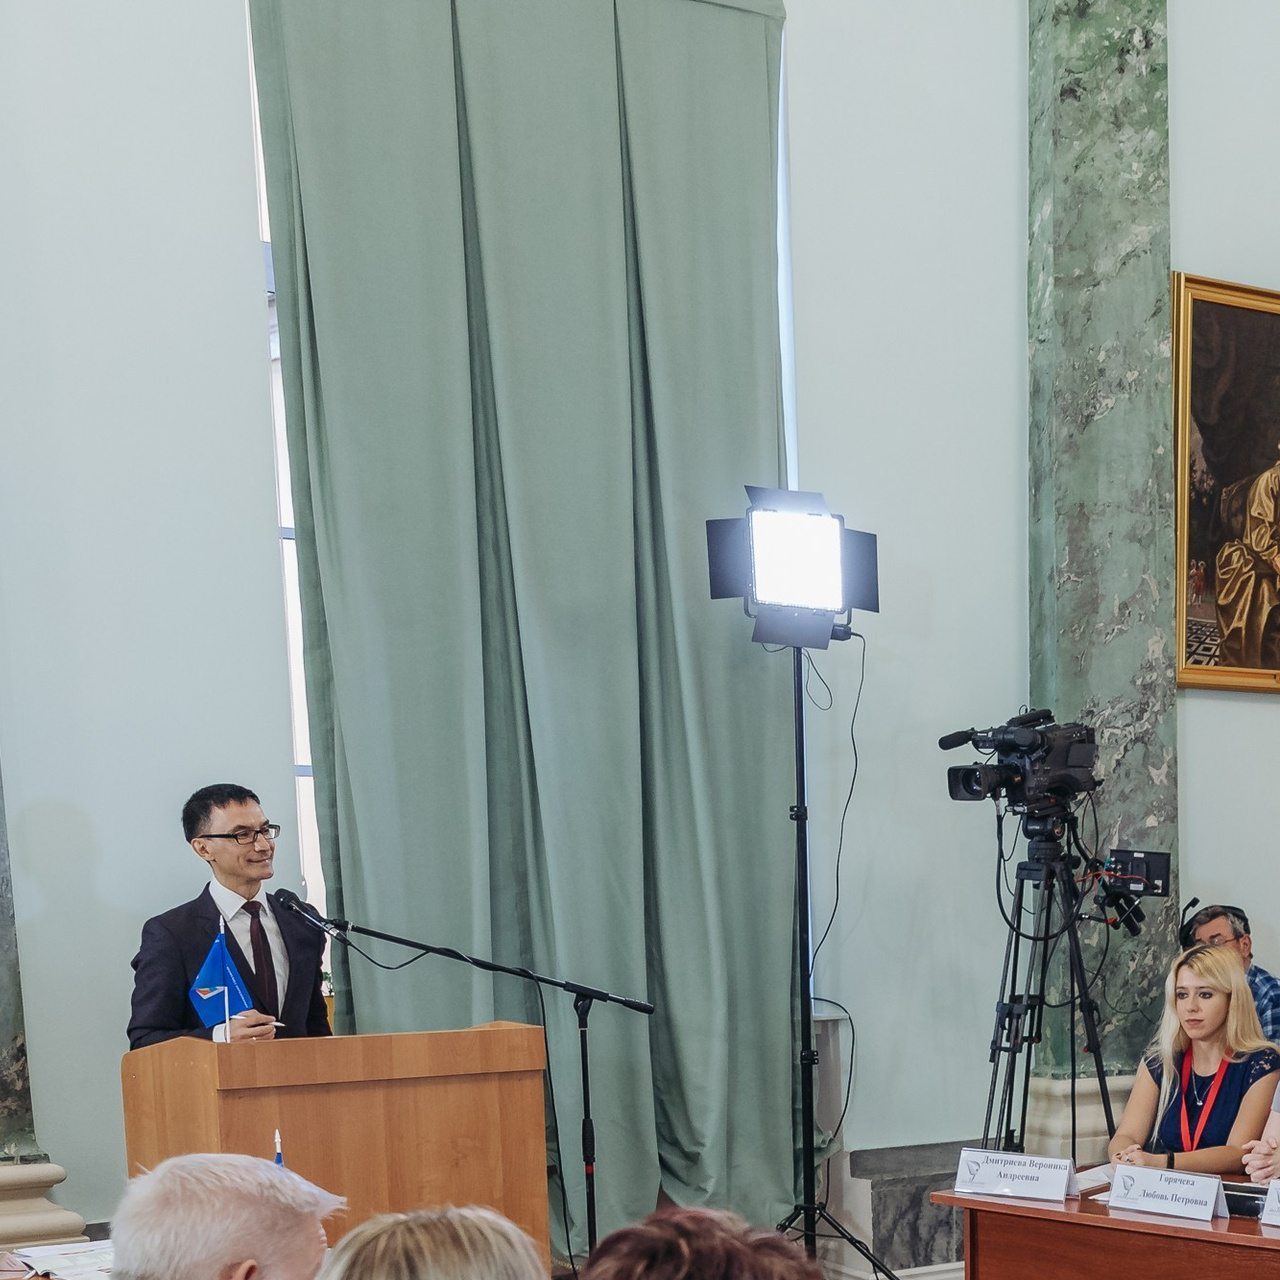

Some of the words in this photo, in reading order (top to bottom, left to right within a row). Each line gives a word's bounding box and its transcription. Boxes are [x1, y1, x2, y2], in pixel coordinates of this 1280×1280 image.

[981, 1155, 1027, 1167] Дмитриева
[1028, 1159, 1068, 1171] Вероника
[997, 1171, 1040, 1182] Андреевна
[1159, 1173, 1195, 1187] Горячева
[1139, 1189, 1169, 1201] Любовь
[1170, 1194, 1208, 1207] Петровна
